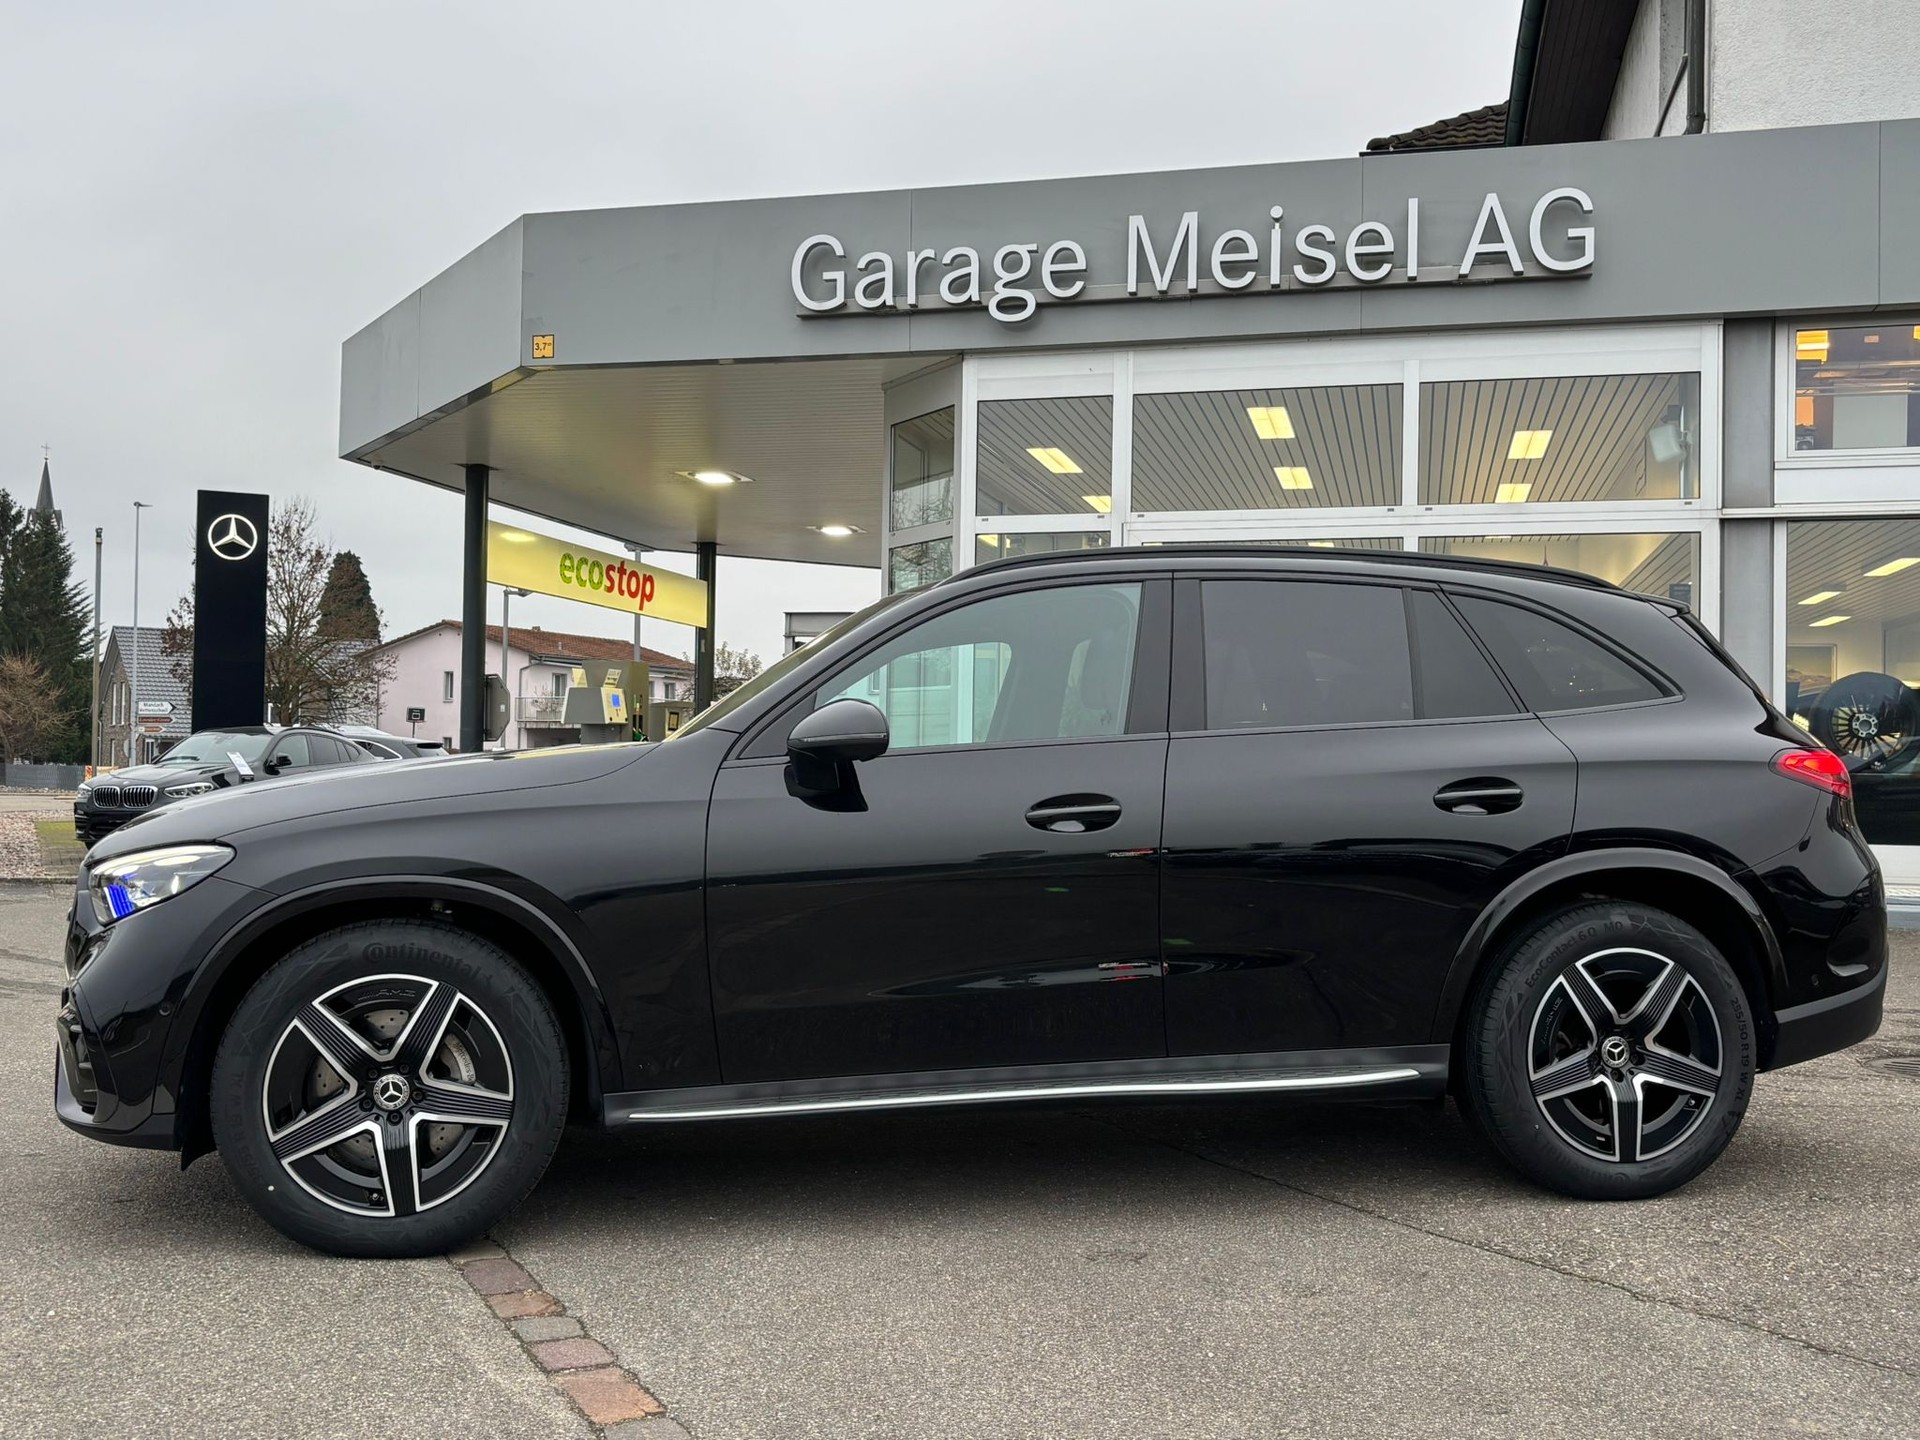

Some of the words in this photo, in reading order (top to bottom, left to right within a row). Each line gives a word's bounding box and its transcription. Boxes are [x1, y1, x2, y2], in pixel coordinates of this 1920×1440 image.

[791, 234, 1087, 322] Garage
[1127, 197, 1418, 295] Meisel
[1458, 187, 1595, 279] AG
[560, 552, 655, 611] ecostop
[362, 941, 482, 980] Continental
[1525, 936, 1576, 988] EcoContact
